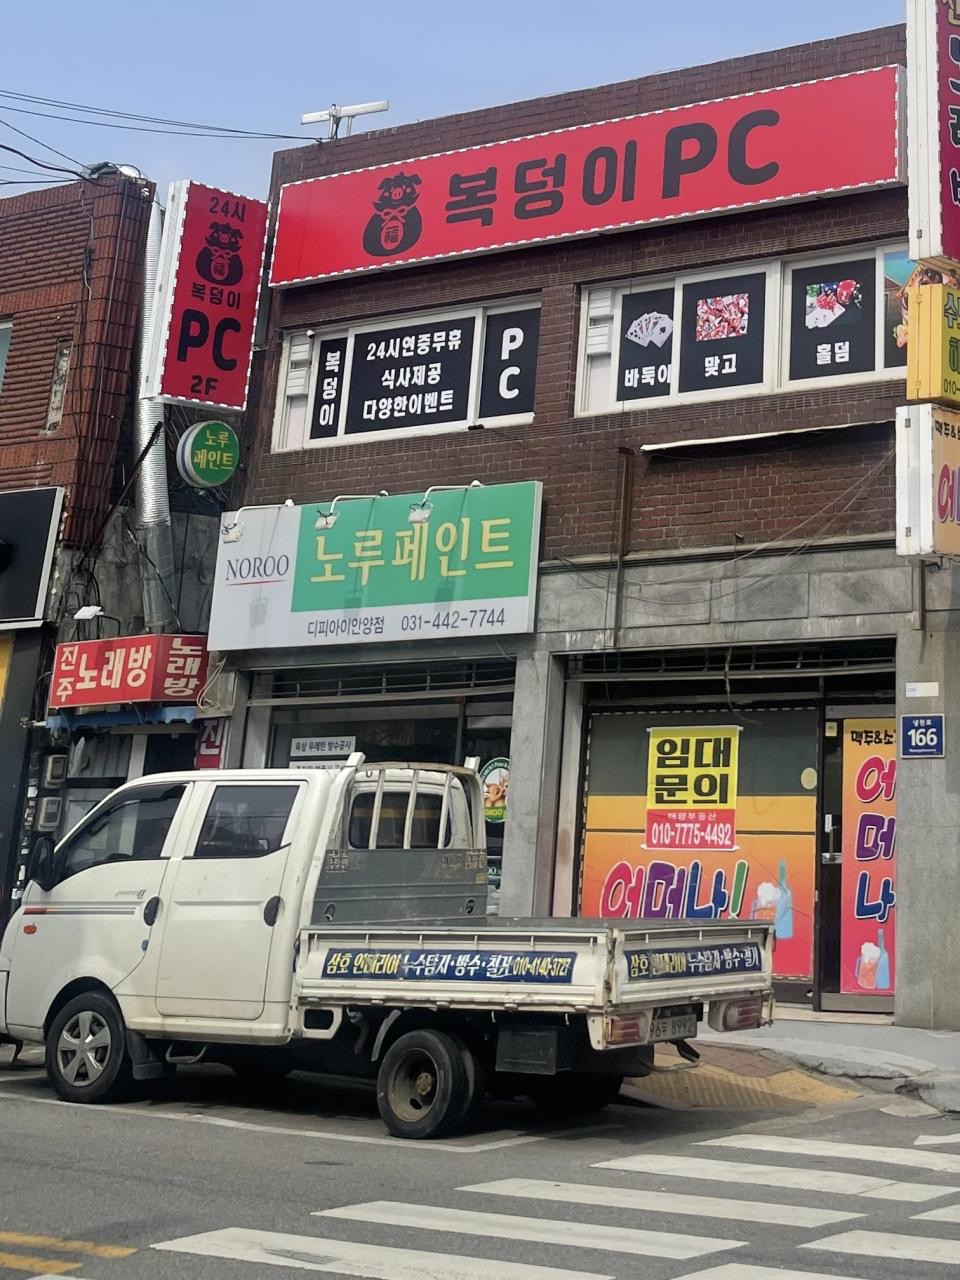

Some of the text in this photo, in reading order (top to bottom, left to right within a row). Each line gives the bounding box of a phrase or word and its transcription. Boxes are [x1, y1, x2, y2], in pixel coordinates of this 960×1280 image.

[209, 197, 246, 223] 24시
[192, 282, 241, 309] 복덩이
[177, 309, 242, 371] PC
[366, 329, 462, 361] 24시연중무휴
[816, 341, 851, 365] 홀덤
[381, 363, 442, 390] 식사제공
[704, 354, 737, 377] 맞고
[190, 375, 218, 395] 2F
[319, 351, 340, 426] 복덩이
[363, 389, 454, 420] 다양한이벤트
[204, 430, 230, 448] 노루
[193, 449, 233, 470] 페인트
[309, 517, 514, 586] 노루페인트
[225, 554, 289, 581] NOROO
[400, 608, 505, 632] 031-442-7744
[56, 645, 152, 703] 진주 노래방
[163, 637, 203, 696] 노래방
[851, 729, 896, 746] 맥주&소
[907, 728, 938, 746] 166
[655, 737, 732, 769] 임대
[654, 773, 729, 805] 문의
[651, 822, 732, 845] 010-7775-4492
[601, 860, 749, 918] 어머나!
[327, 952, 352, 974] 삼호
[630, 953, 649, 977] 삼호
